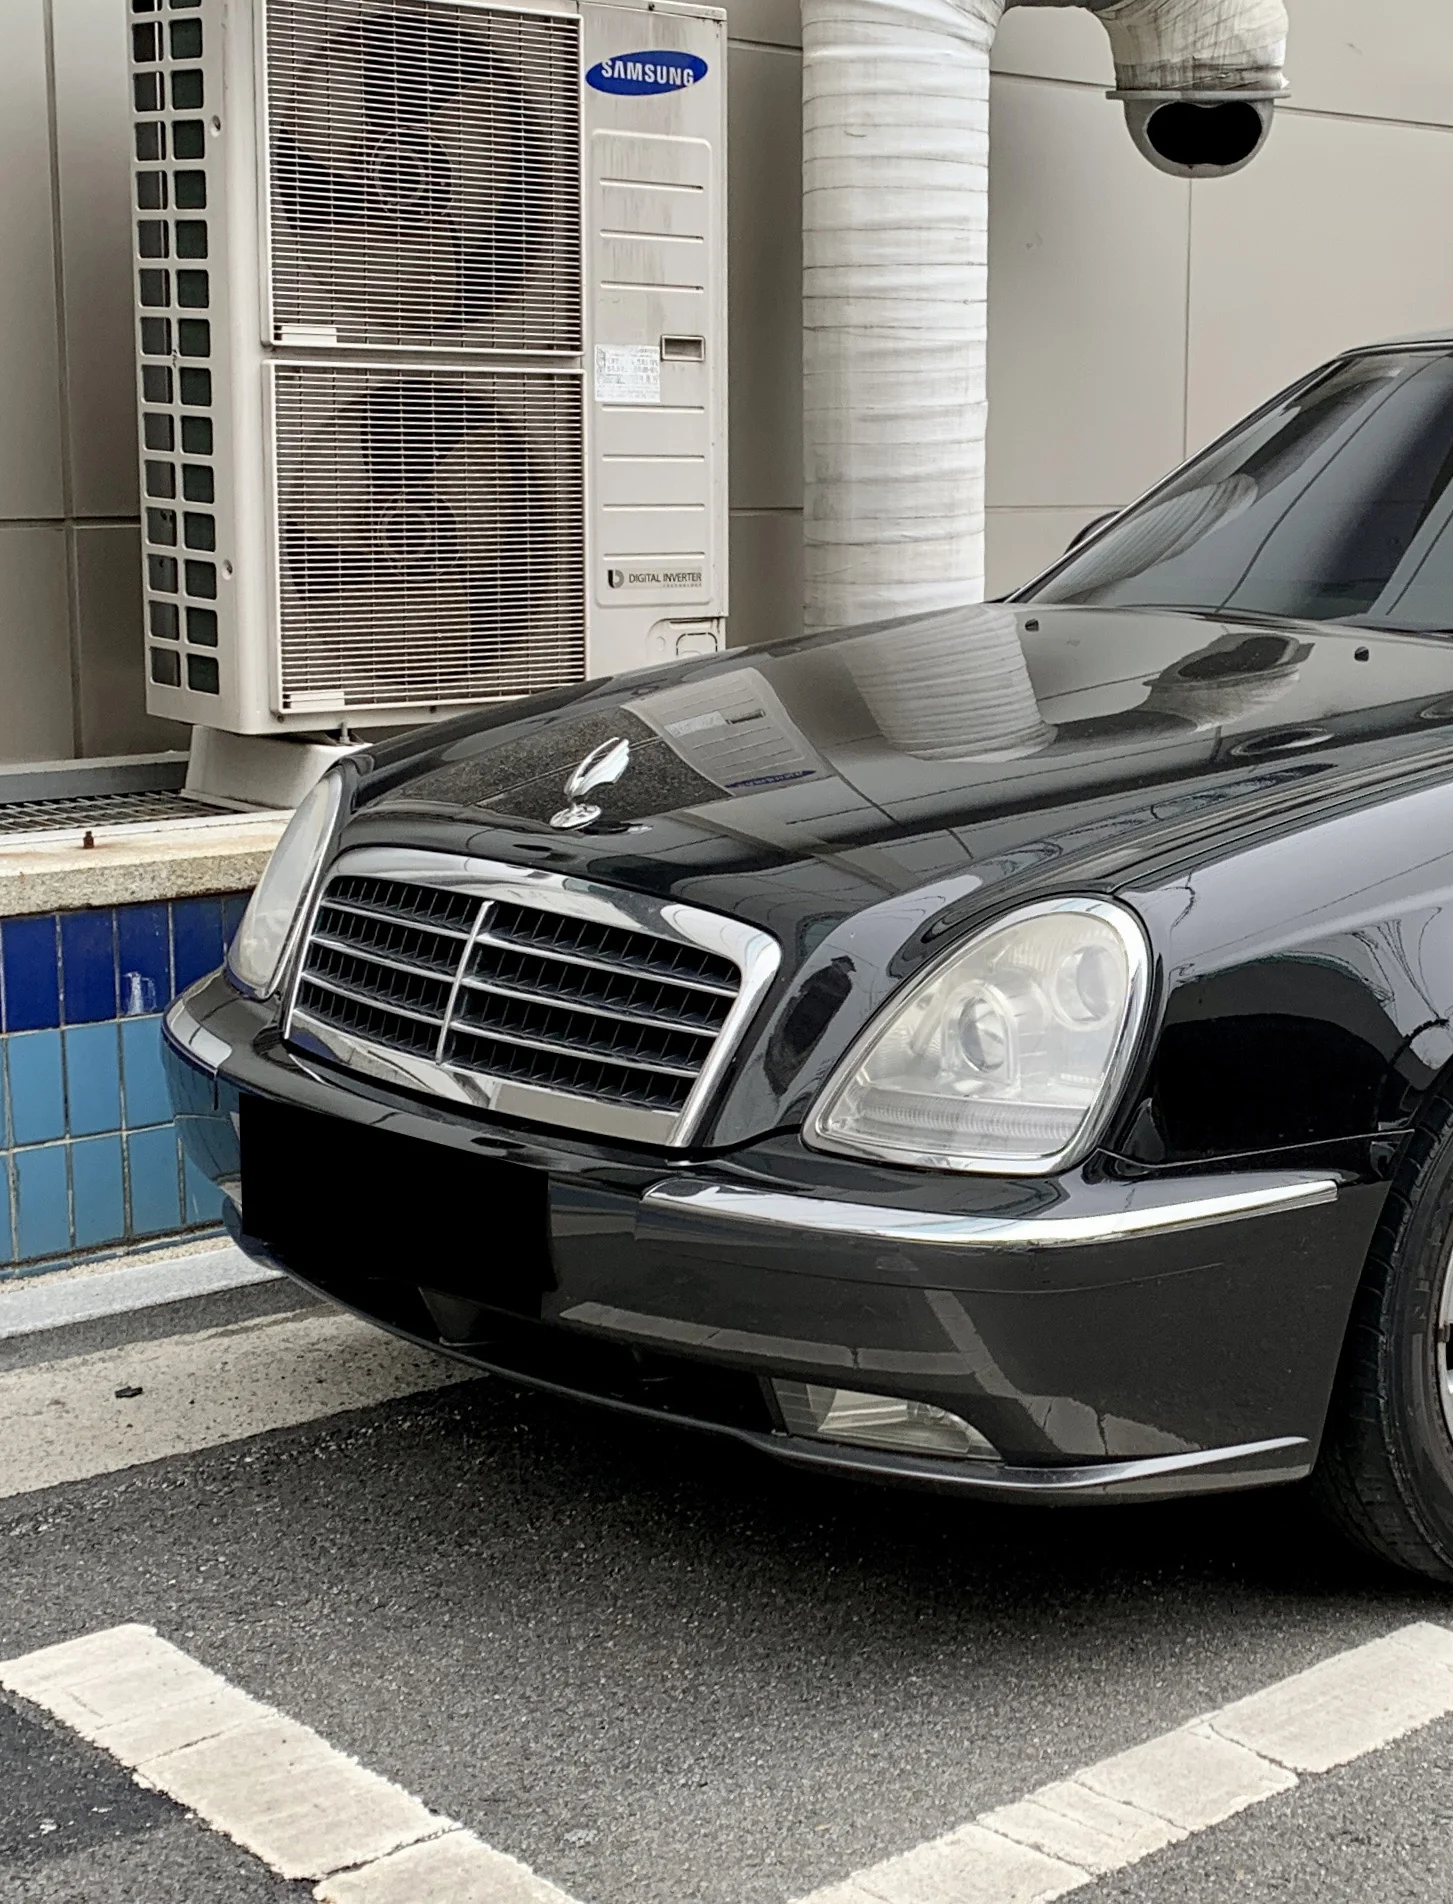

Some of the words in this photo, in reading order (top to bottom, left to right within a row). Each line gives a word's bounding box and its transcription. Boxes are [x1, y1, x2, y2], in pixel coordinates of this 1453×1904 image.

[600, 60, 695, 87] SAMSUNG
[628, 573, 661, 583] DIGITAL
[663, 572, 702, 582] INVERTER
